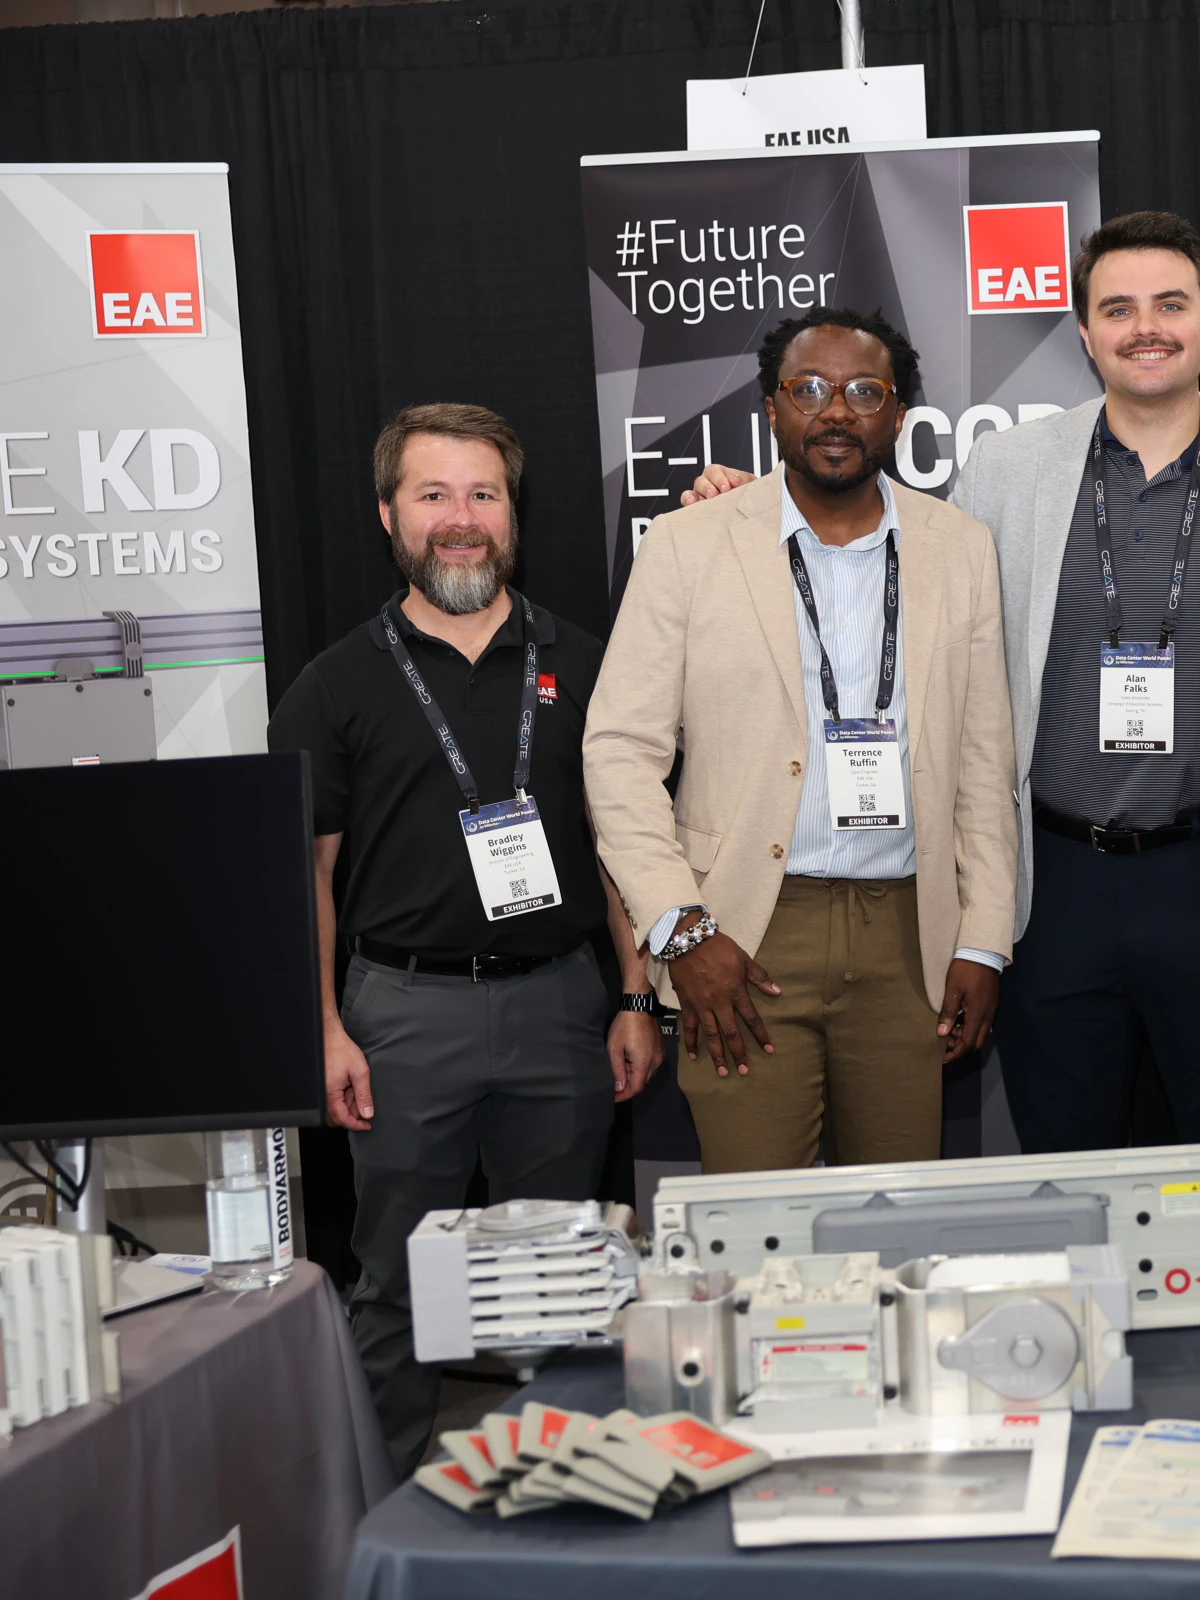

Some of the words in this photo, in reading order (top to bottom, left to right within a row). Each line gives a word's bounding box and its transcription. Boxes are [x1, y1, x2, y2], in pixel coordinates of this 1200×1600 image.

[616, 218, 806, 267] #Future
[977, 265, 1062, 304] EAE
[617, 262, 835, 325] Together
[102, 292, 194, 328] EAE
[78, 428, 221, 513] KD
[0, 529, 224, 579] YSTEMS
[1125, 674, 1146, 683] Alan
[1124, 684, 1148, 693] Falks
[539, 697, 553, 705] USA
[842, 749, 882, 757] Terrence
[1115, 742, 1155, 750] EXHIBITOR
[850, 758, 877, 767] Ruffin
[848, 817, 888, 825] EXHIBITOR
[487, 833, 524, 847] Bradley
[490, 843, 527, 857] Wiggins
[503, 898, 544, 914] EXHIBITOR
[272, 1127, 290, 1245] BODYARMO
